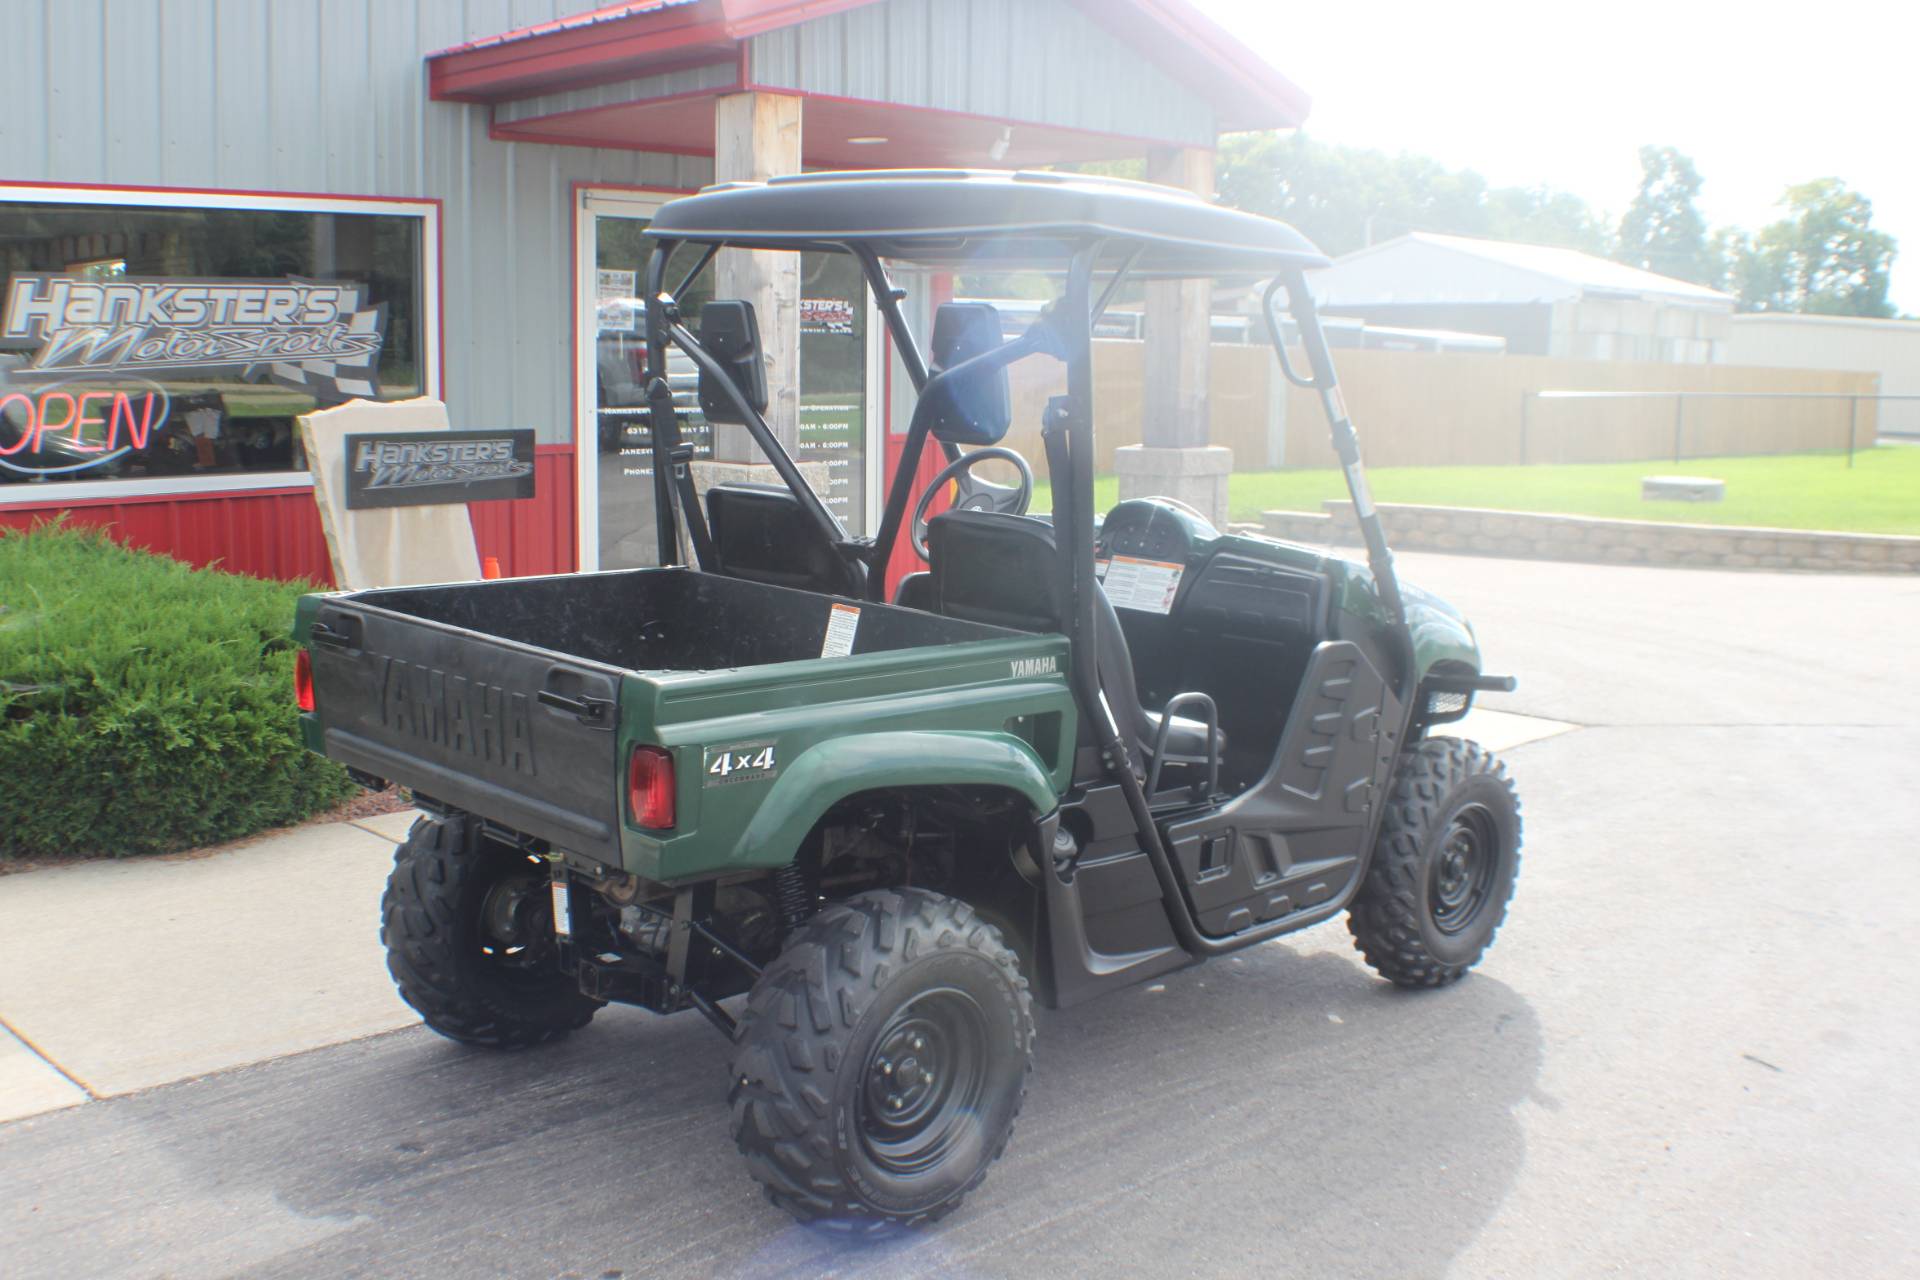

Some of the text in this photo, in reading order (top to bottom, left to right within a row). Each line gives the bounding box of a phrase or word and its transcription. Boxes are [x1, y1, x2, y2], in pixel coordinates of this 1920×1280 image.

[0, 392, 154, 455] OPEN
[1010, 655, 1057, 679] YAMAHA
[367, 651, 537, 777] YAMAHA
